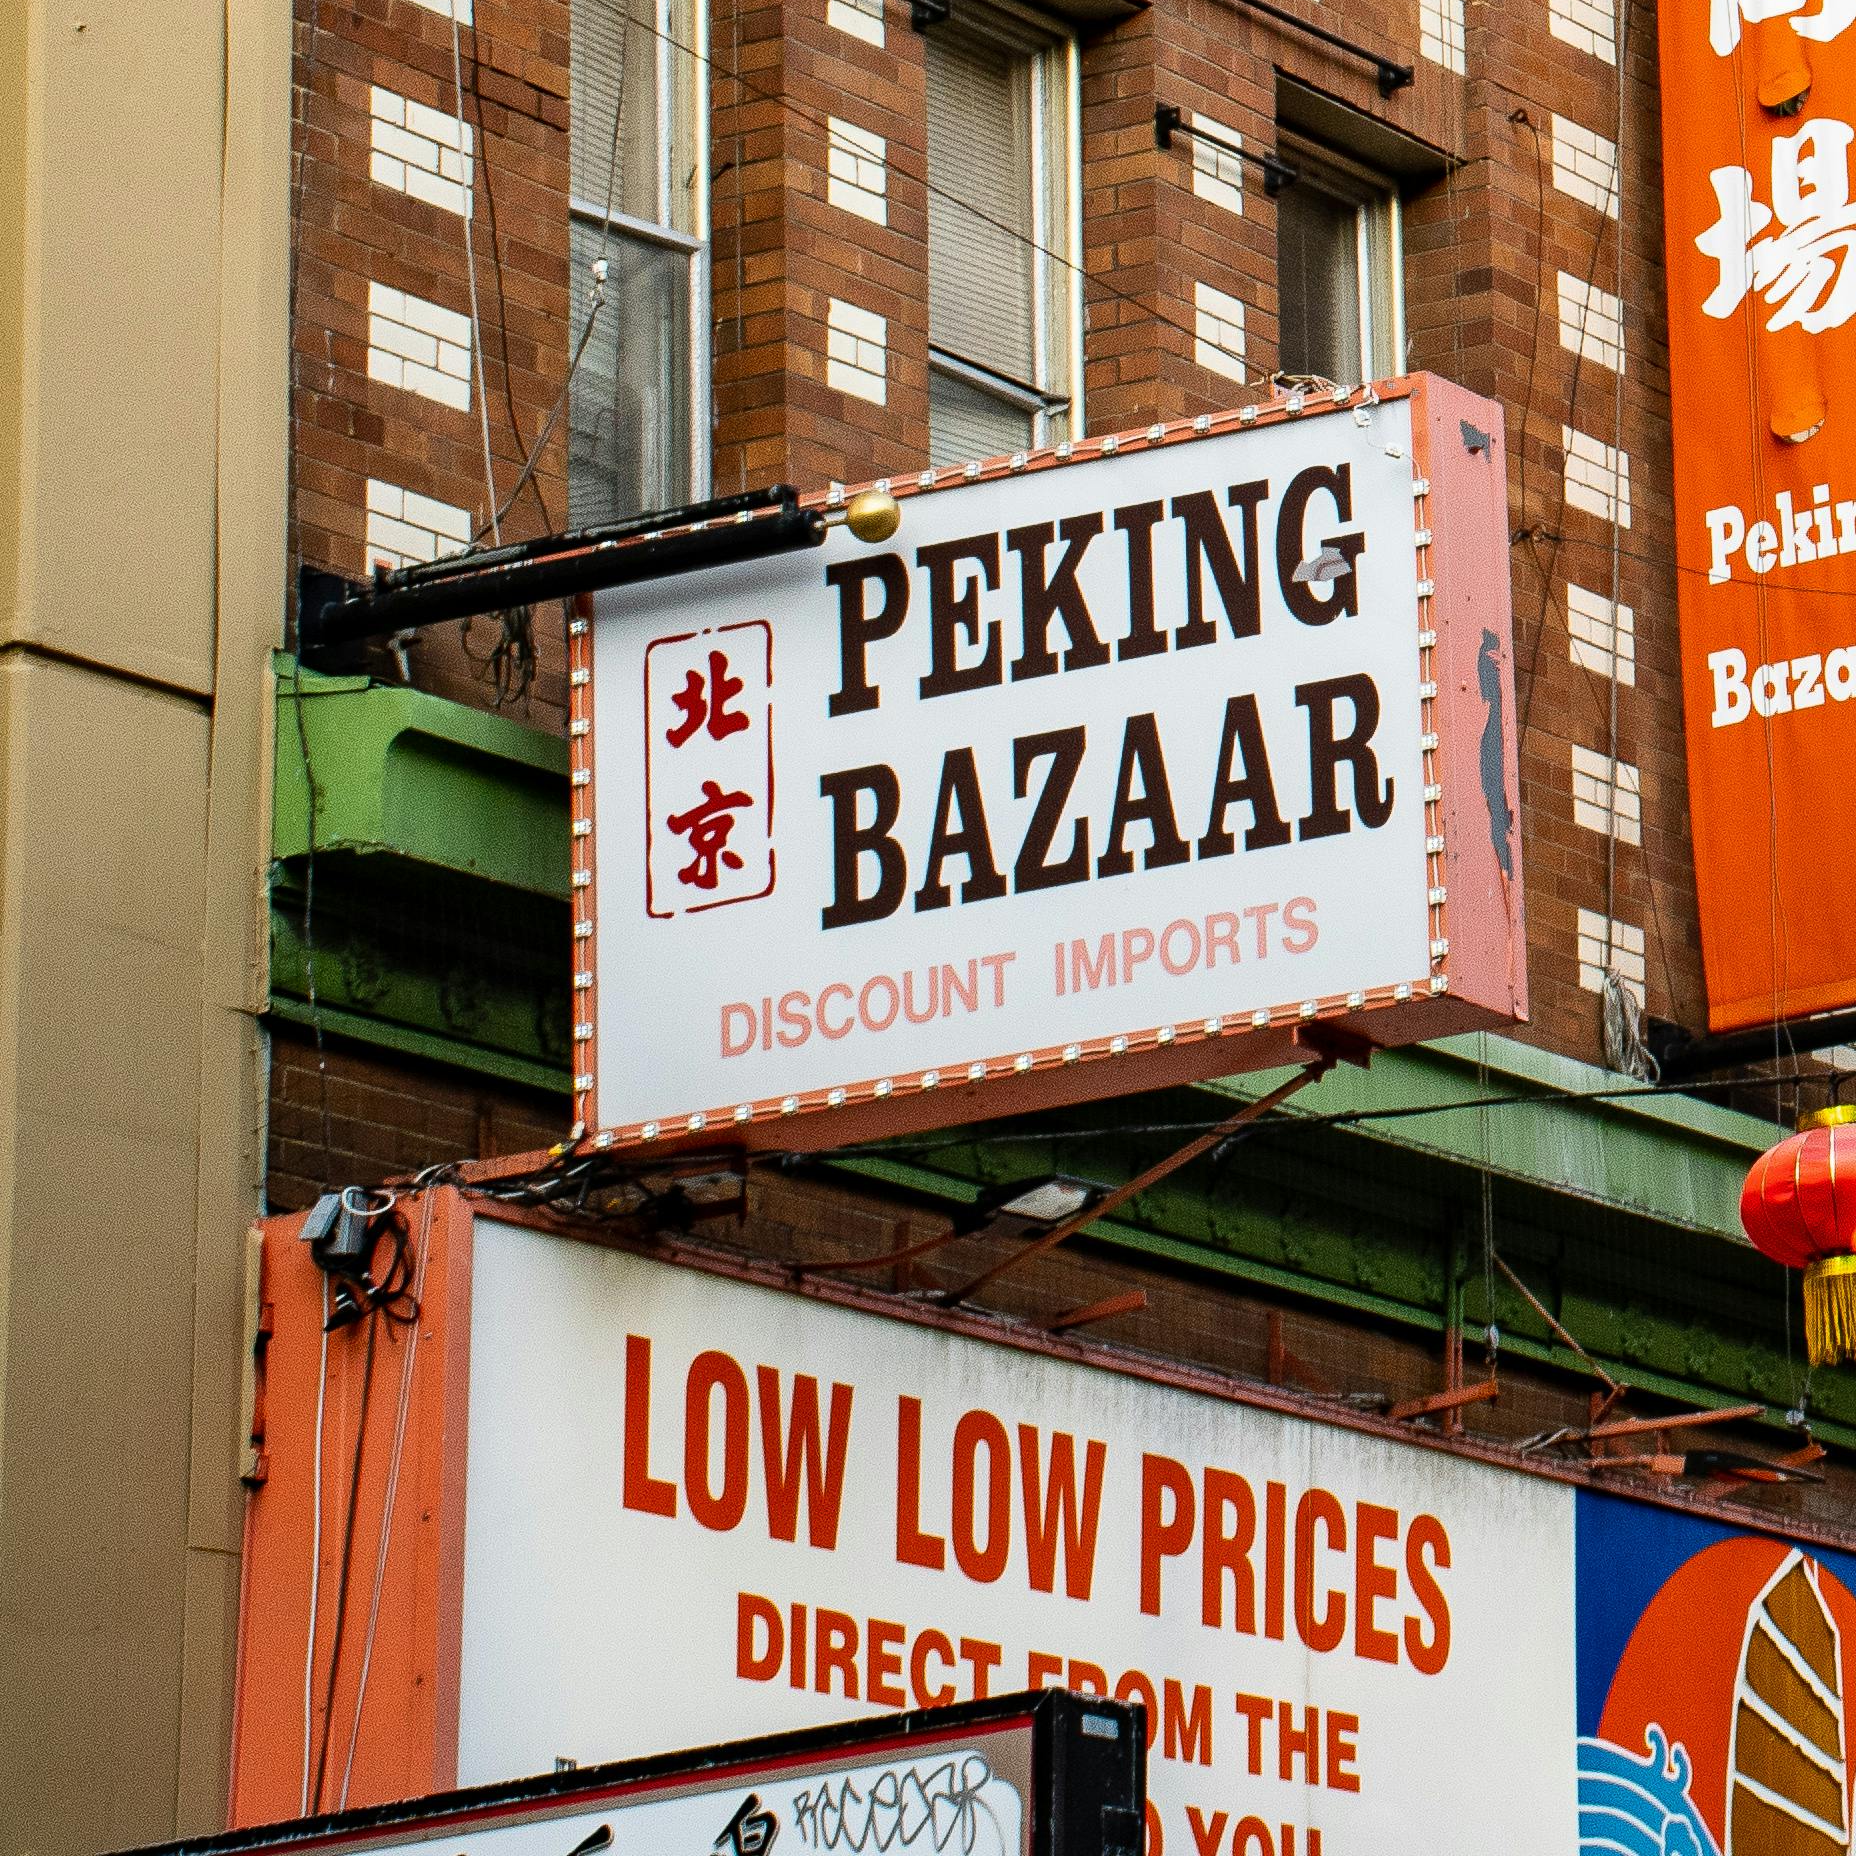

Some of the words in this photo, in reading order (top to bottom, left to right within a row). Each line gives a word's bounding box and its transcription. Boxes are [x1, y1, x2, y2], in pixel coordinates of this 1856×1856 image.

[826, 464, 1364, 717] PEKING
[666, 651, 754, 890] 北京
[820, 673, 1394, 930] BAZAAR
[721, 953, 1016, 1057] DISCOUNT
[1056, 896, 1319, 996] IMPORTS
[623, 1334, 854, 1551] LOW
[896, 1394, 1107, 1601] LOW
[1141, 1453, 1452, 1675] PRICES
[737, 1592, 1001, 1708] DIRECT
[1235, 1691, 1361, 1793] THE
